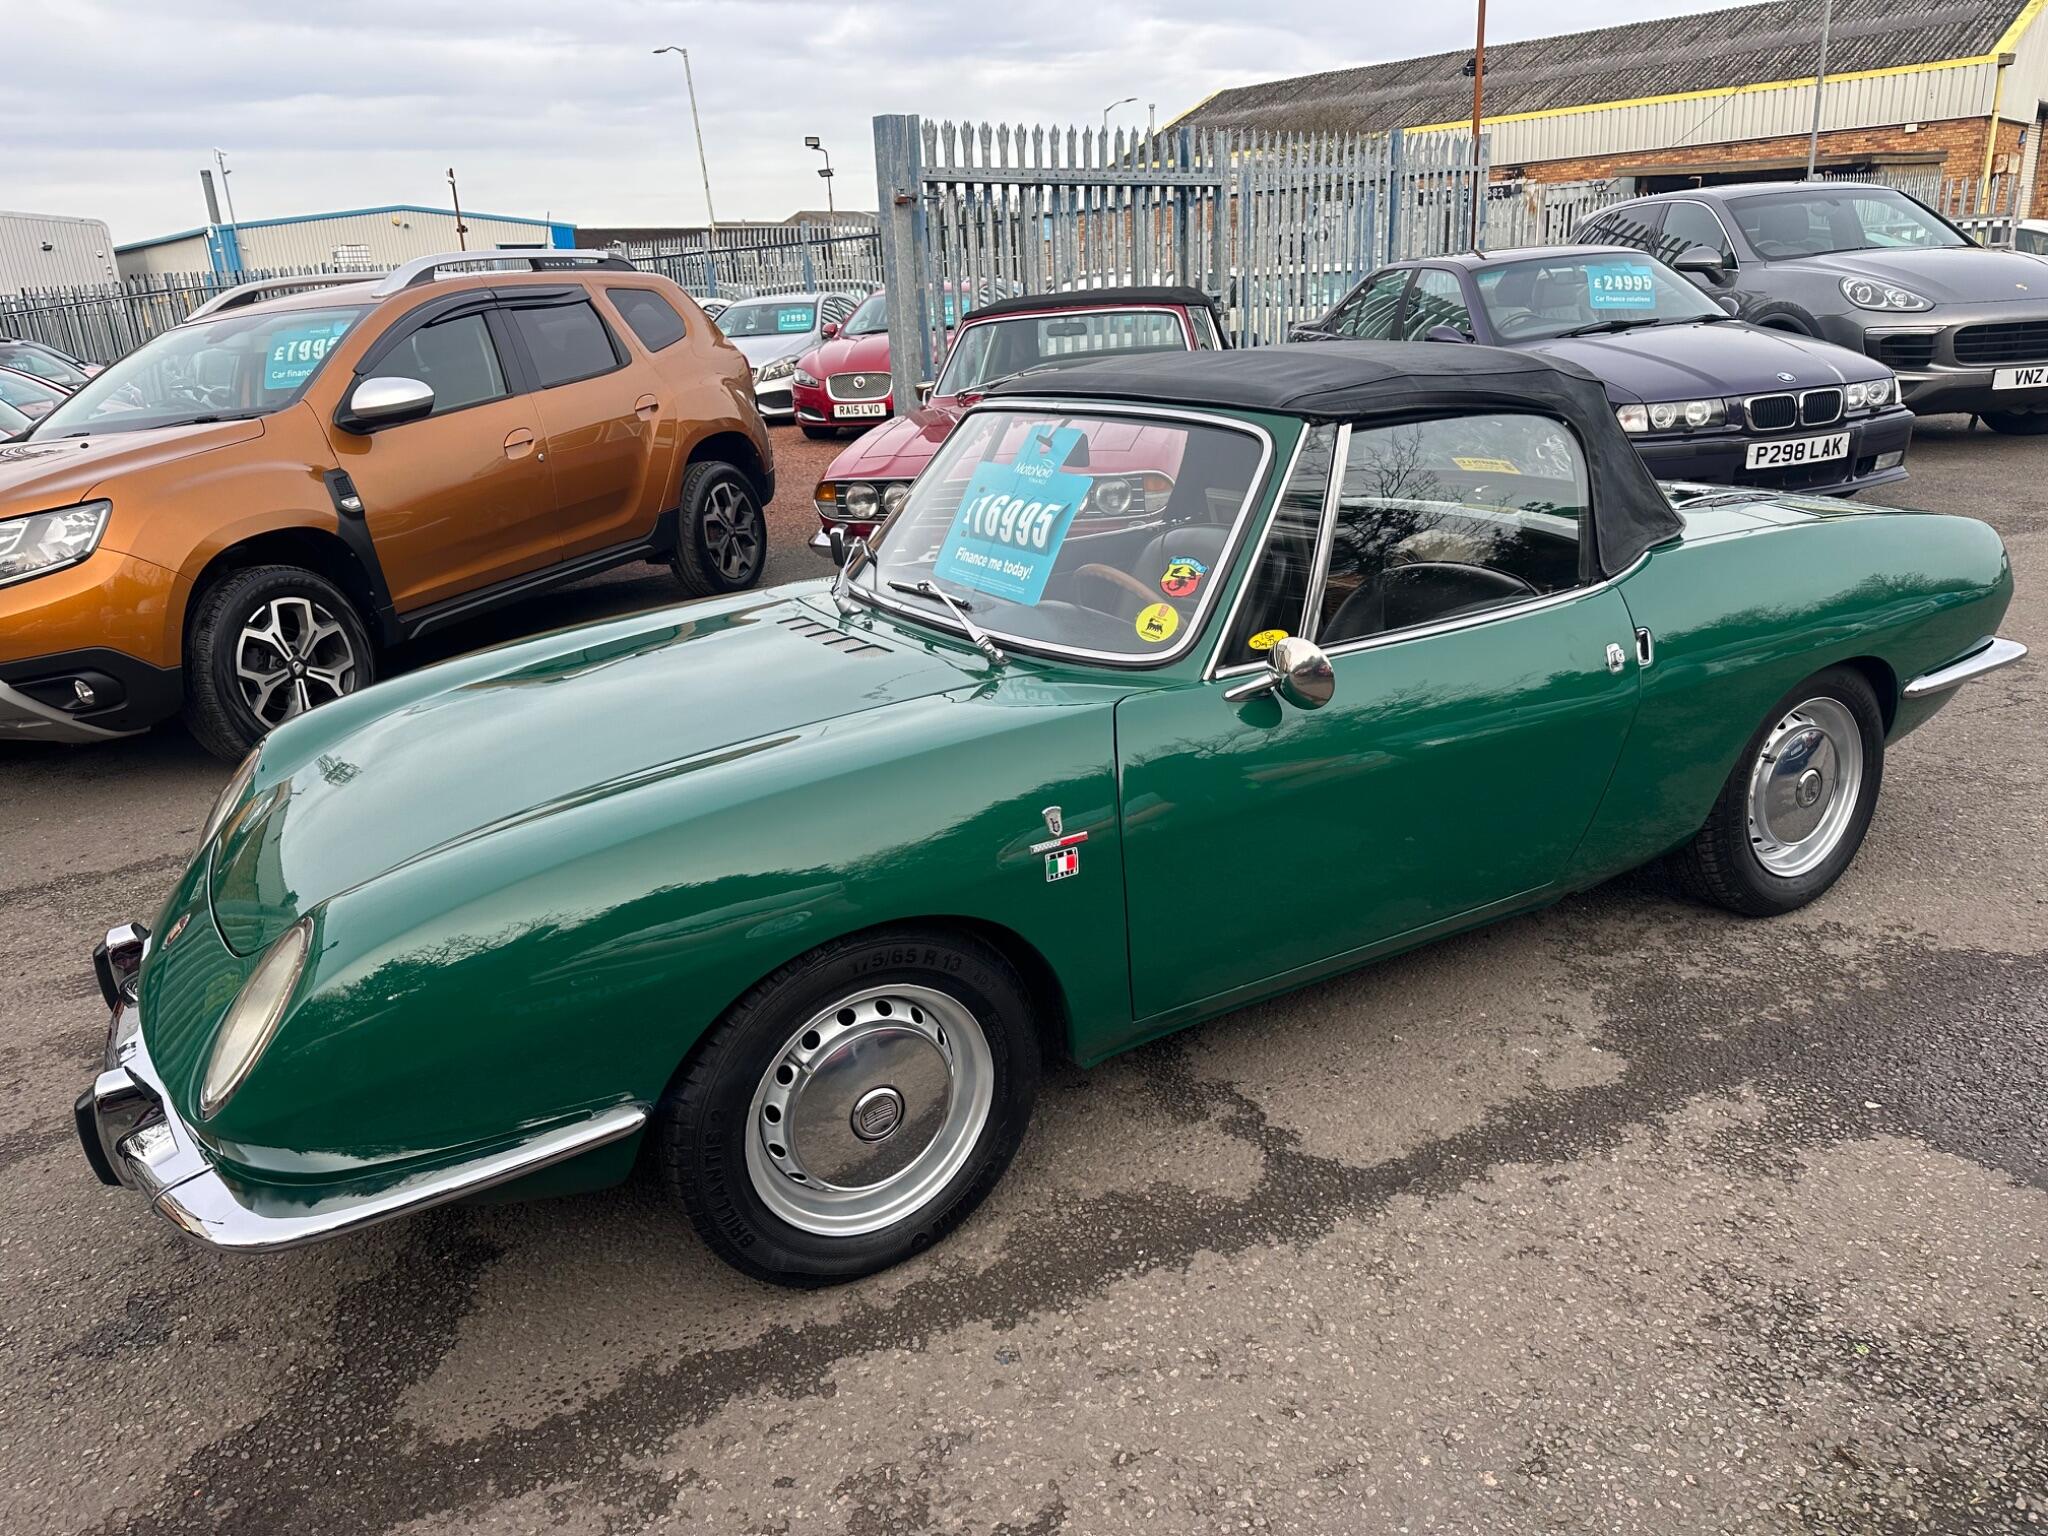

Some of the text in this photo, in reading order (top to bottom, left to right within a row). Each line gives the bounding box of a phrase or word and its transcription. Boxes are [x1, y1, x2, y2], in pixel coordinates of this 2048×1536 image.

[272, 369, 313, 379] Car financ
[2016, 369, 2044, 385] VNZ
[839, 405, 860, 415] RA15
[1755, 437, 1843, 465] P298 LAK
[955, 546, 988, 567] Finance
[988, 557, 1003, 571] me
[1003, 559, 1034, 581] today!
